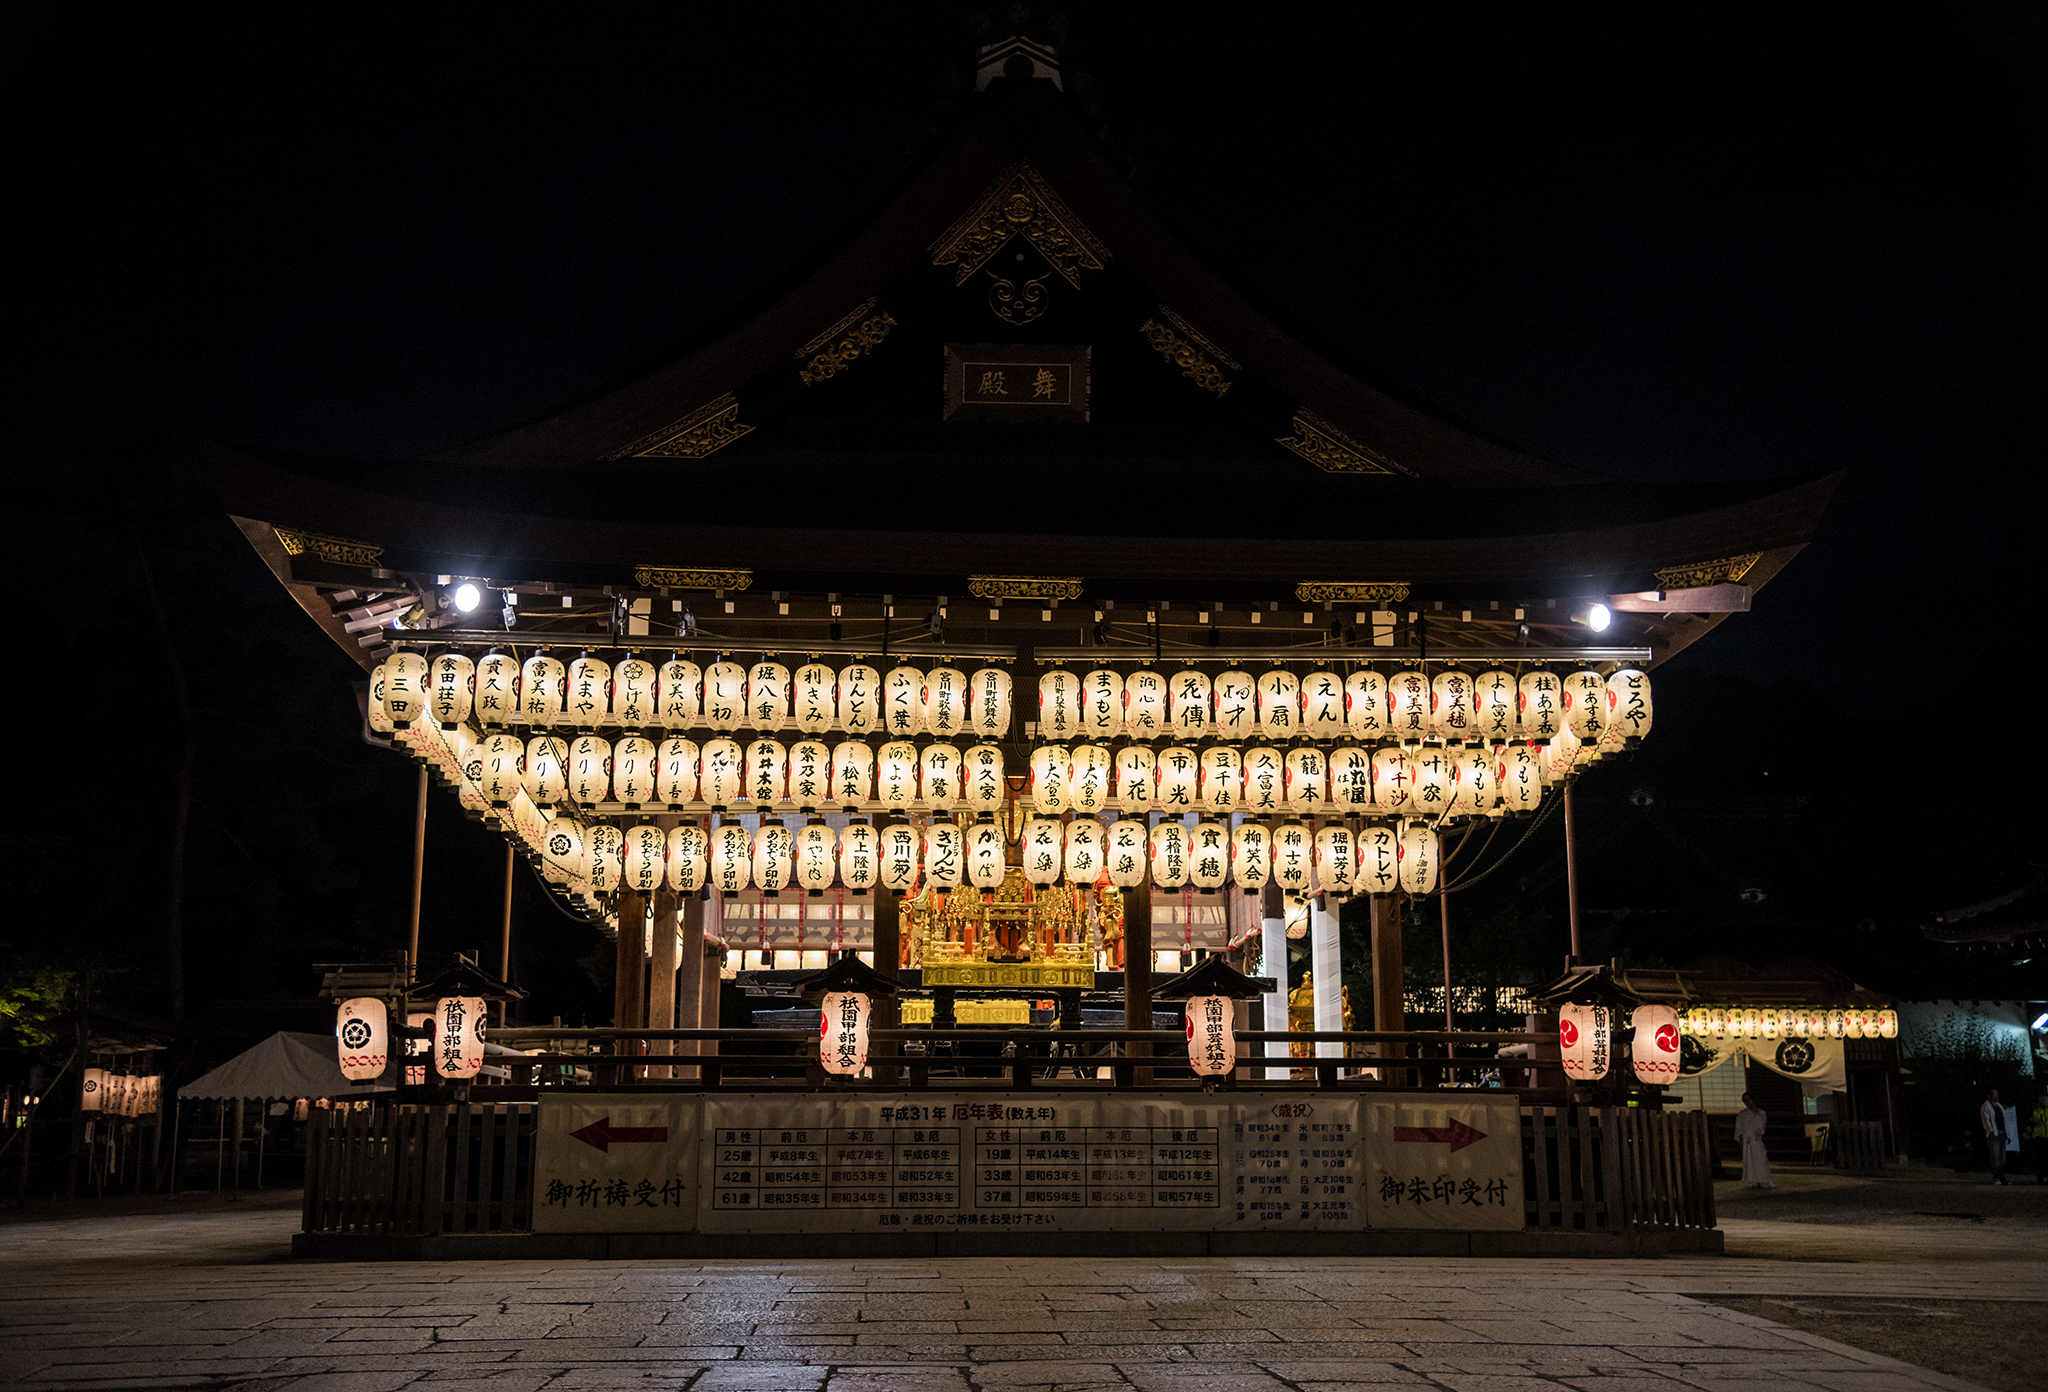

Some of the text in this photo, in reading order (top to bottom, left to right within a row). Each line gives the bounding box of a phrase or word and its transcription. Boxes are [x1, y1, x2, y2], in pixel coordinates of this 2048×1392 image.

[437, 657, 458, 716] 家田荘子
[574, 662, 595, 716] たまや
[667, 663, 686, 719] 富美代
[892, 673, 911, 729] ふく葉
[935, 671, 953, 730] 宮川町歌舞会
[982, 670, 999, 729] 宮川町歌舞会
[1096, 671, 1112, 728] まつもと
[1269, 676, 1290, 727] 小扇
[1359, 677, 1380, 731] 杉きみ
[1403, 675, 1424, 731] 富美夏
[1624, 675, 1647, 729] どろや
[840, 765, 861, 798] 松本
[1126, 754, 1148, 801] 小花
[1166, 751, 1190, 806] 市光
[1213, 752, 1232, 807] 豆千佳
[1472, 753, 1487, 808] ちもと
[1516, 748, 1531, 802] ちもと
[1374, 831, 1393, 886] カトレヤ
[880, 1106, 947, 1122] 平成31年
[723, 1150, 752, 1162] 25歳
[769, 1150, 818, 1162] 平成8年生
[836, 1149, 885, 1162] 平成7年生
[902, 1149, 951, 1161] 平成6年生
[985, 1149, 1012, 1161] 19歳
[1025, 1149, 1080, 1161] 平成14年生
[1157, 1149, 1213, 1161] 平成12年生
[722, 1171, 752, 1184] 42歳
[764, 1171, 821, 1183] 昭和54年生
[831, 1170, 888, 1182] 昭和53年生
[898, 1170, 955, 1182] 昭和52年生
[983, 1170, 1012, 1182] 33歳
[1025, 1170, 1081, 1182] 昭和63年生
[1157, 1170, 1213, 1182] 昭和61年生
[545, 1177, 686, 1209] 御祈祷受付
[764, 1192, 821, 1204] 昭和35年生
[831, 1192, 888, 1204] 昭和34年生
[898, 1192, 955, 1204] 昭和33年生
[983, 1190, 1012, 1203] 37歳
[1025, 1190, 1081, 1203] 昭和59年生
[1157, 1190, 1214, 1203] 昭和57年生
[1378, 1175, 1509, 1207] 御朱印受付
[722, 1192, 751, 1205] 61歳
